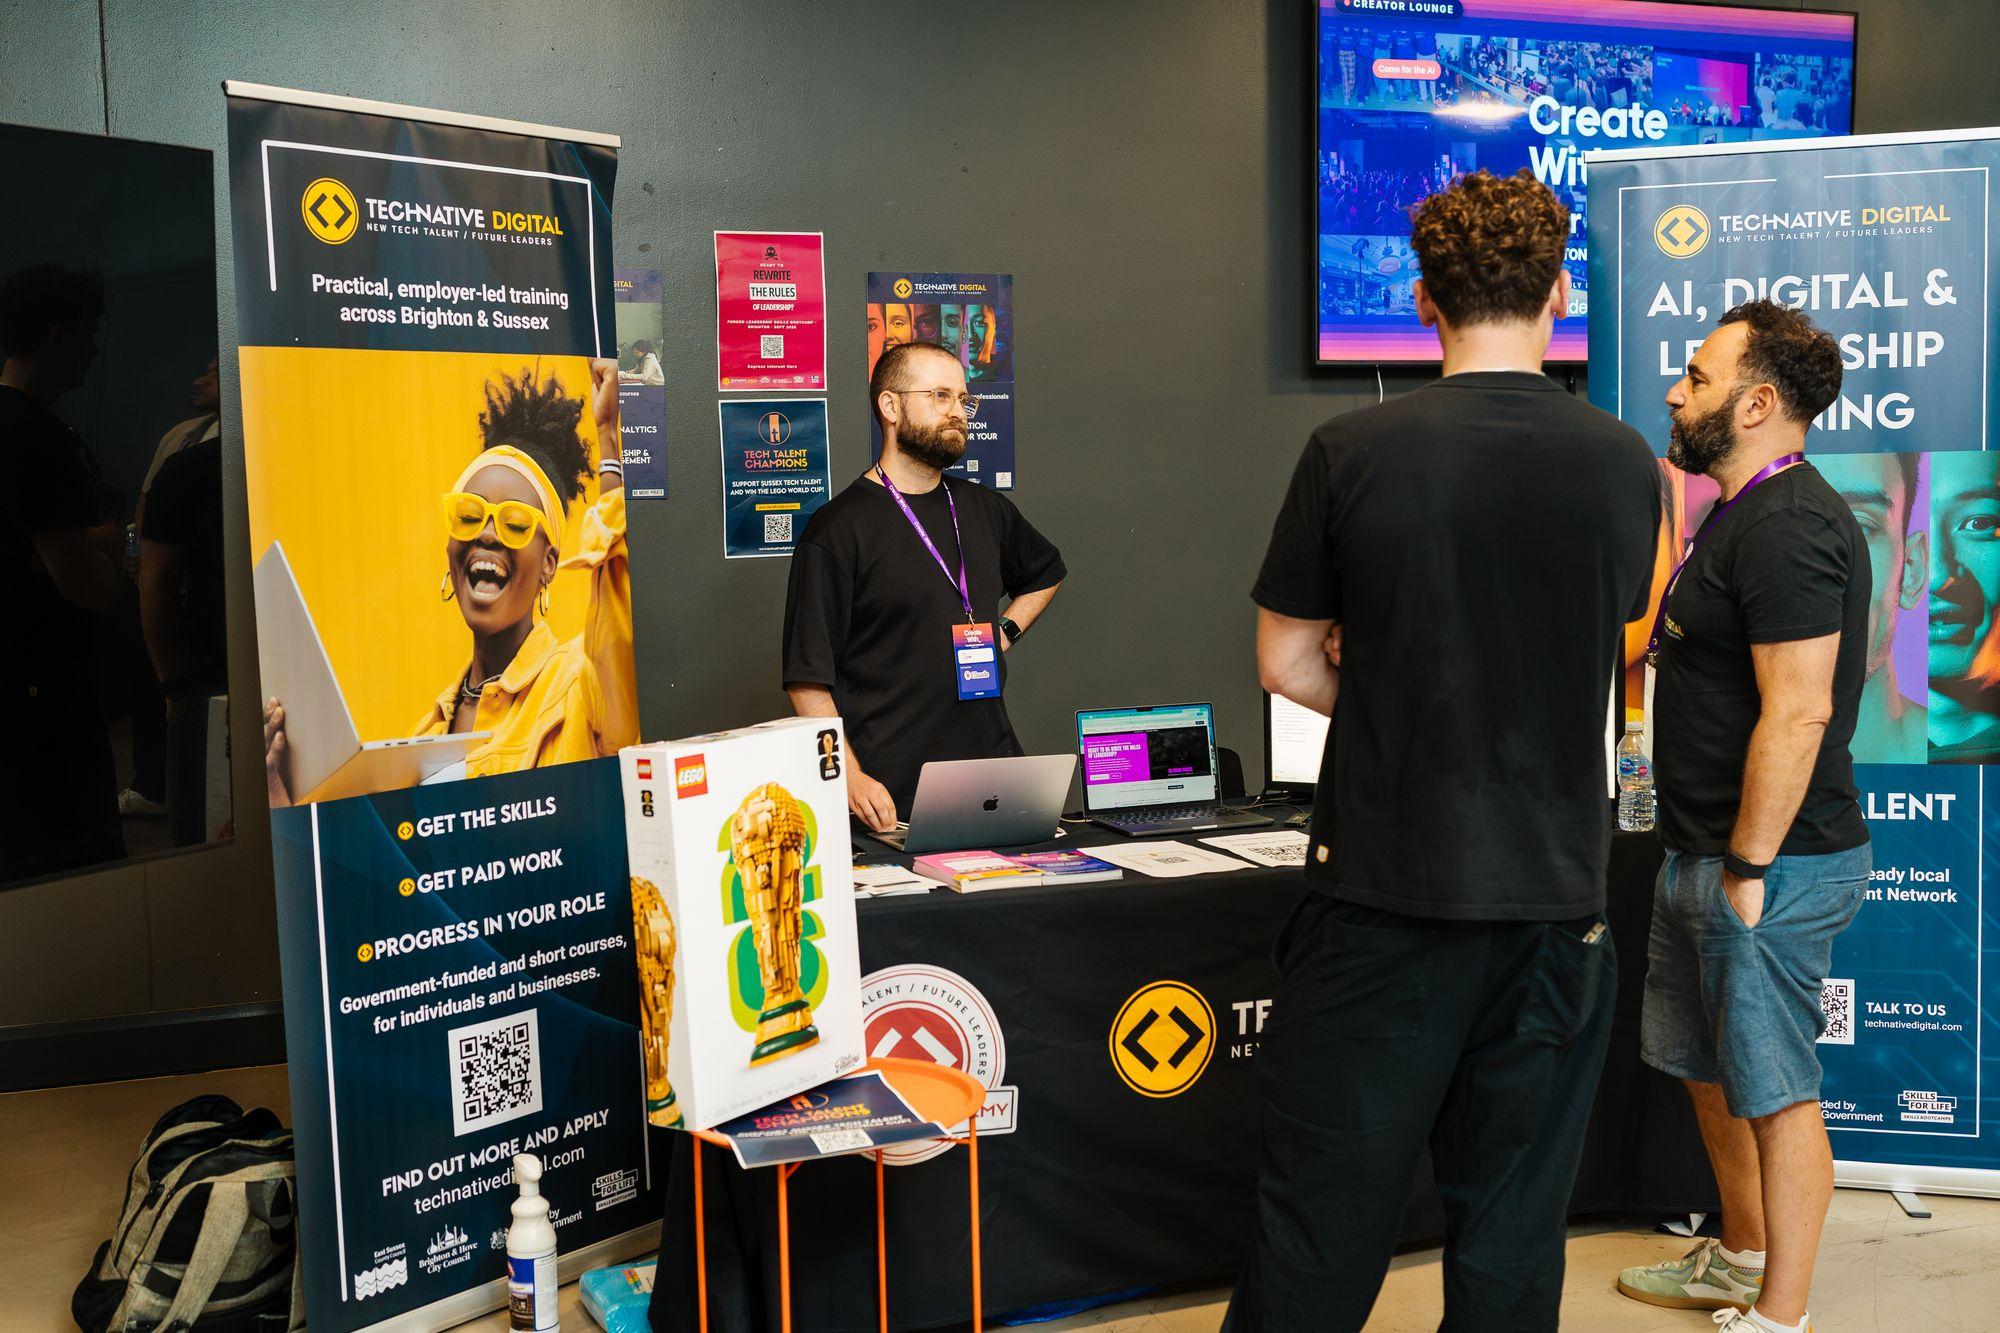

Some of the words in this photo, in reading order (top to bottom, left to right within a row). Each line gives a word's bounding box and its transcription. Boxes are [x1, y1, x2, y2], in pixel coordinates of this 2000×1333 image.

[1353, 0, 1405, 11] CREATOR
[1409, 2, 1454, 14] LOUNGE
[1378, 65, 1400, 73] Come
[1402, 65, 1412, 74] for
[1413, 66, 1425, 74] the
[1528, 95, 1668, 140] Create
[1528, 145, 1588, 186] Wit
[365, 198, 485, 228] TECHNATIVE
[492, 210, 563, 235] DIGITAL
[1719, 209, 1851, 232] TECHNATIVE
[1862, 204, 1951, 225] DIGITAL
[366, 222, 387, 232] NEW
[392, 225, 418, 235] TECH
[423, 227, 459, 239] TALENT
[471, 232, 507, 243] FUTURE
[511, 235, 552, 246] LEADERS
[1718, 235, 1741, 243] NEW
[1746, 234, 1774, 242] TECH
[1779, 231, 1820, 240] TALENT
[1835, 228, 1878, 238] FUTURE
[1884, 226, 1933, 235] LEADERS
[753, 270, 791, 280] REWRITE
[312, 273, 394, 300] Practical,
[397, 281, 505, 304] employer-led
[509, 287, 569, 310] training
[751, 287, 767, 297] THE
[769, 287, 795, 297] RULES
[914, 283, 957, 291] TECHNATIVE
[1646, 280, 1708, 322] AI,
[1724, 271, 1908, 313] DIGITAL
[1922, 268, 1957, 306] &
[340, 305, 397, 324] across
[401, 306, 473, 329] Brighton
[477, 310, 489, 328] &
[492, 310, 550, 330] Sussex
[744, 450, 770, 459] TECH
[773, 449, 807, 458] TALENT
[744, 458, 808, 469] CHAMPIONS
[732, 480, 760, 488] SUPPORT
[677, 766, 705, 785] LEGO
[1858, 793, 1956, 821] LENT
[416, 813, 456, 838] GET
[460, 806, 496, 830] THE
[500, 796, 557, 823] SKILLS
[417, 869, 456, 893] GET
[461, 860, 506, 886] PAID
[509, 848, 563, 875] WORK
[1868, 867, 1905, 884] eady
[1910, 867, 1950, 882] local
[1887, 888, 1958, 903] Network
[374, 920, 479, 960] PROGRESS
[483, 914, 503, 936] IN
[506, 903, 556, 931] YOUR
[560, 892, 606, 917] ROLE
[339, 961, 496, 1014] Government-funded
[499, 954, 526, 976] and
[529, 944, 566, 968] short
[568, 934, 627, 958] courses,
[373, 1015, 397, 1034] for
[399, 994, 485, 1028] individuals
[488, 985, 516, 1006] and
[518, 967, 601, 998] businesses.
[1865, 1002, 1900, 1014] TALK
[1903, 1003, 1923, 1015] TO
[1927, 1004, 1946, 1016] US
[862, 985, 901, 1008] ALENT
[923, 984, 969, 1014] FUTURE
[968, 1017, 988, 1076] LEADERS
[1864, 1020, 1962, 1031] technativedigital.com
[1231, 1042, 1260, 1058] NE
[1904, 1091, 1936, 1100] SKILLS
[1843, 1101, 1856, 1111] by
[1910, 1101, 1928, 1110] FOR
[1931, 1102, 1950, 1111] LIFE
[1821, 1110, 1883, 1122] Government
[382, 1168, 423, 1197] FIND
[427, 1154, 465, 1181] OUT
[470, 1137, 520, 1169] MORE
[524, 1126, 558, 1151] AND
[562, 1108, 609, 1138] APPLY
[413, 1146, 585, 1214] technativedil.com
[597, 1171, 622, 1186] SKILLS
[602, 1184, 617, 1196] FOR
[618, 1179, 634, 1190] LIFE
[549, 1208, 560, 1220] by
[374, 1249, 386, 1258] East
[386, 1242, 406, 1254] Sussex
[418, 1252, 451, 1268] Brighton
[459, 1242, 478, 1254] Hove
[427, 1263, 441, 1274] City
[443, 1251, 471, 1269] Council
